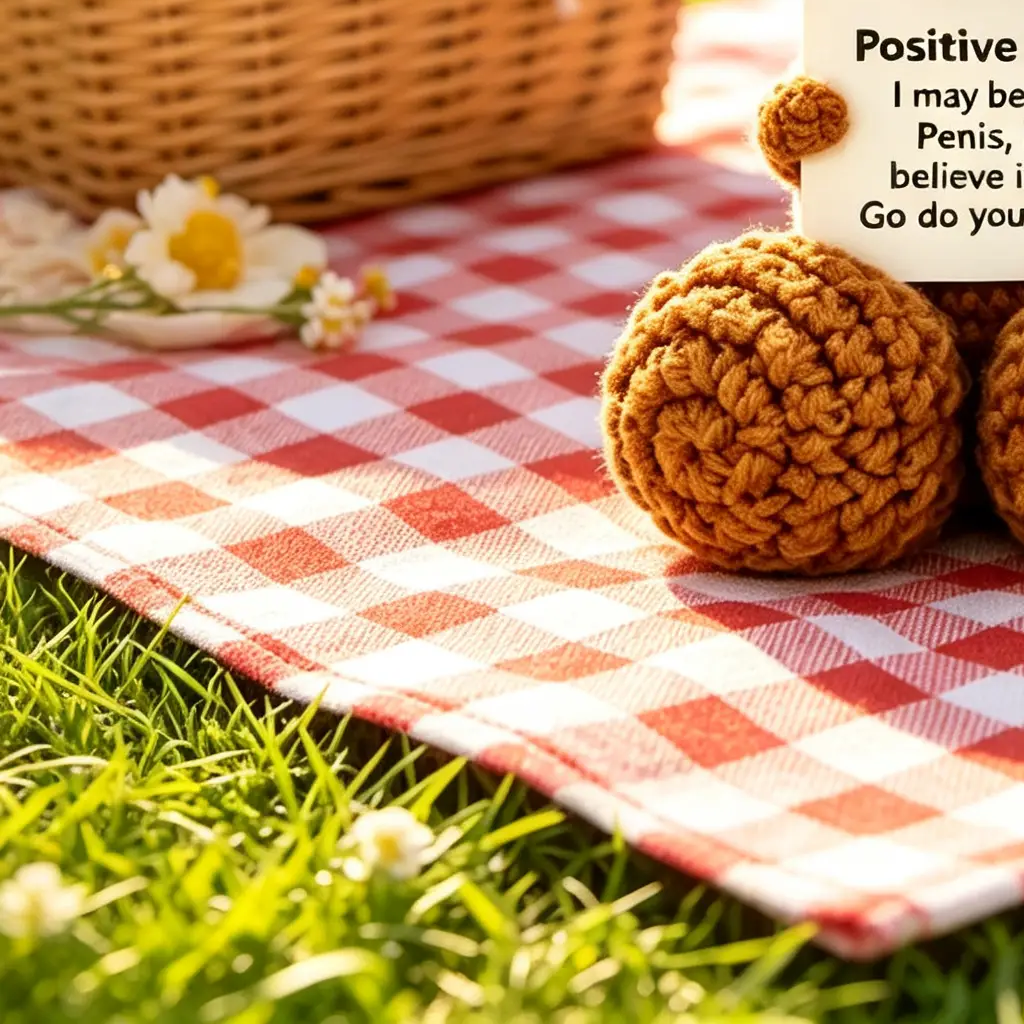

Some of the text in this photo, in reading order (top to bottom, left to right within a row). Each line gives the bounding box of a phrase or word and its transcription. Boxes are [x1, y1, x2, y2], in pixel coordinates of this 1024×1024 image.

[856, 27, 1018, 63] Positive
[894, 80, 901, 108] I
[913, 88, 979, 116] may
[917, 121, 1012, 155] Penis,
[890, 160, 1004, 190] believe
[859, 200, 907, 230] Go
[918, 200, 959, 229] do
